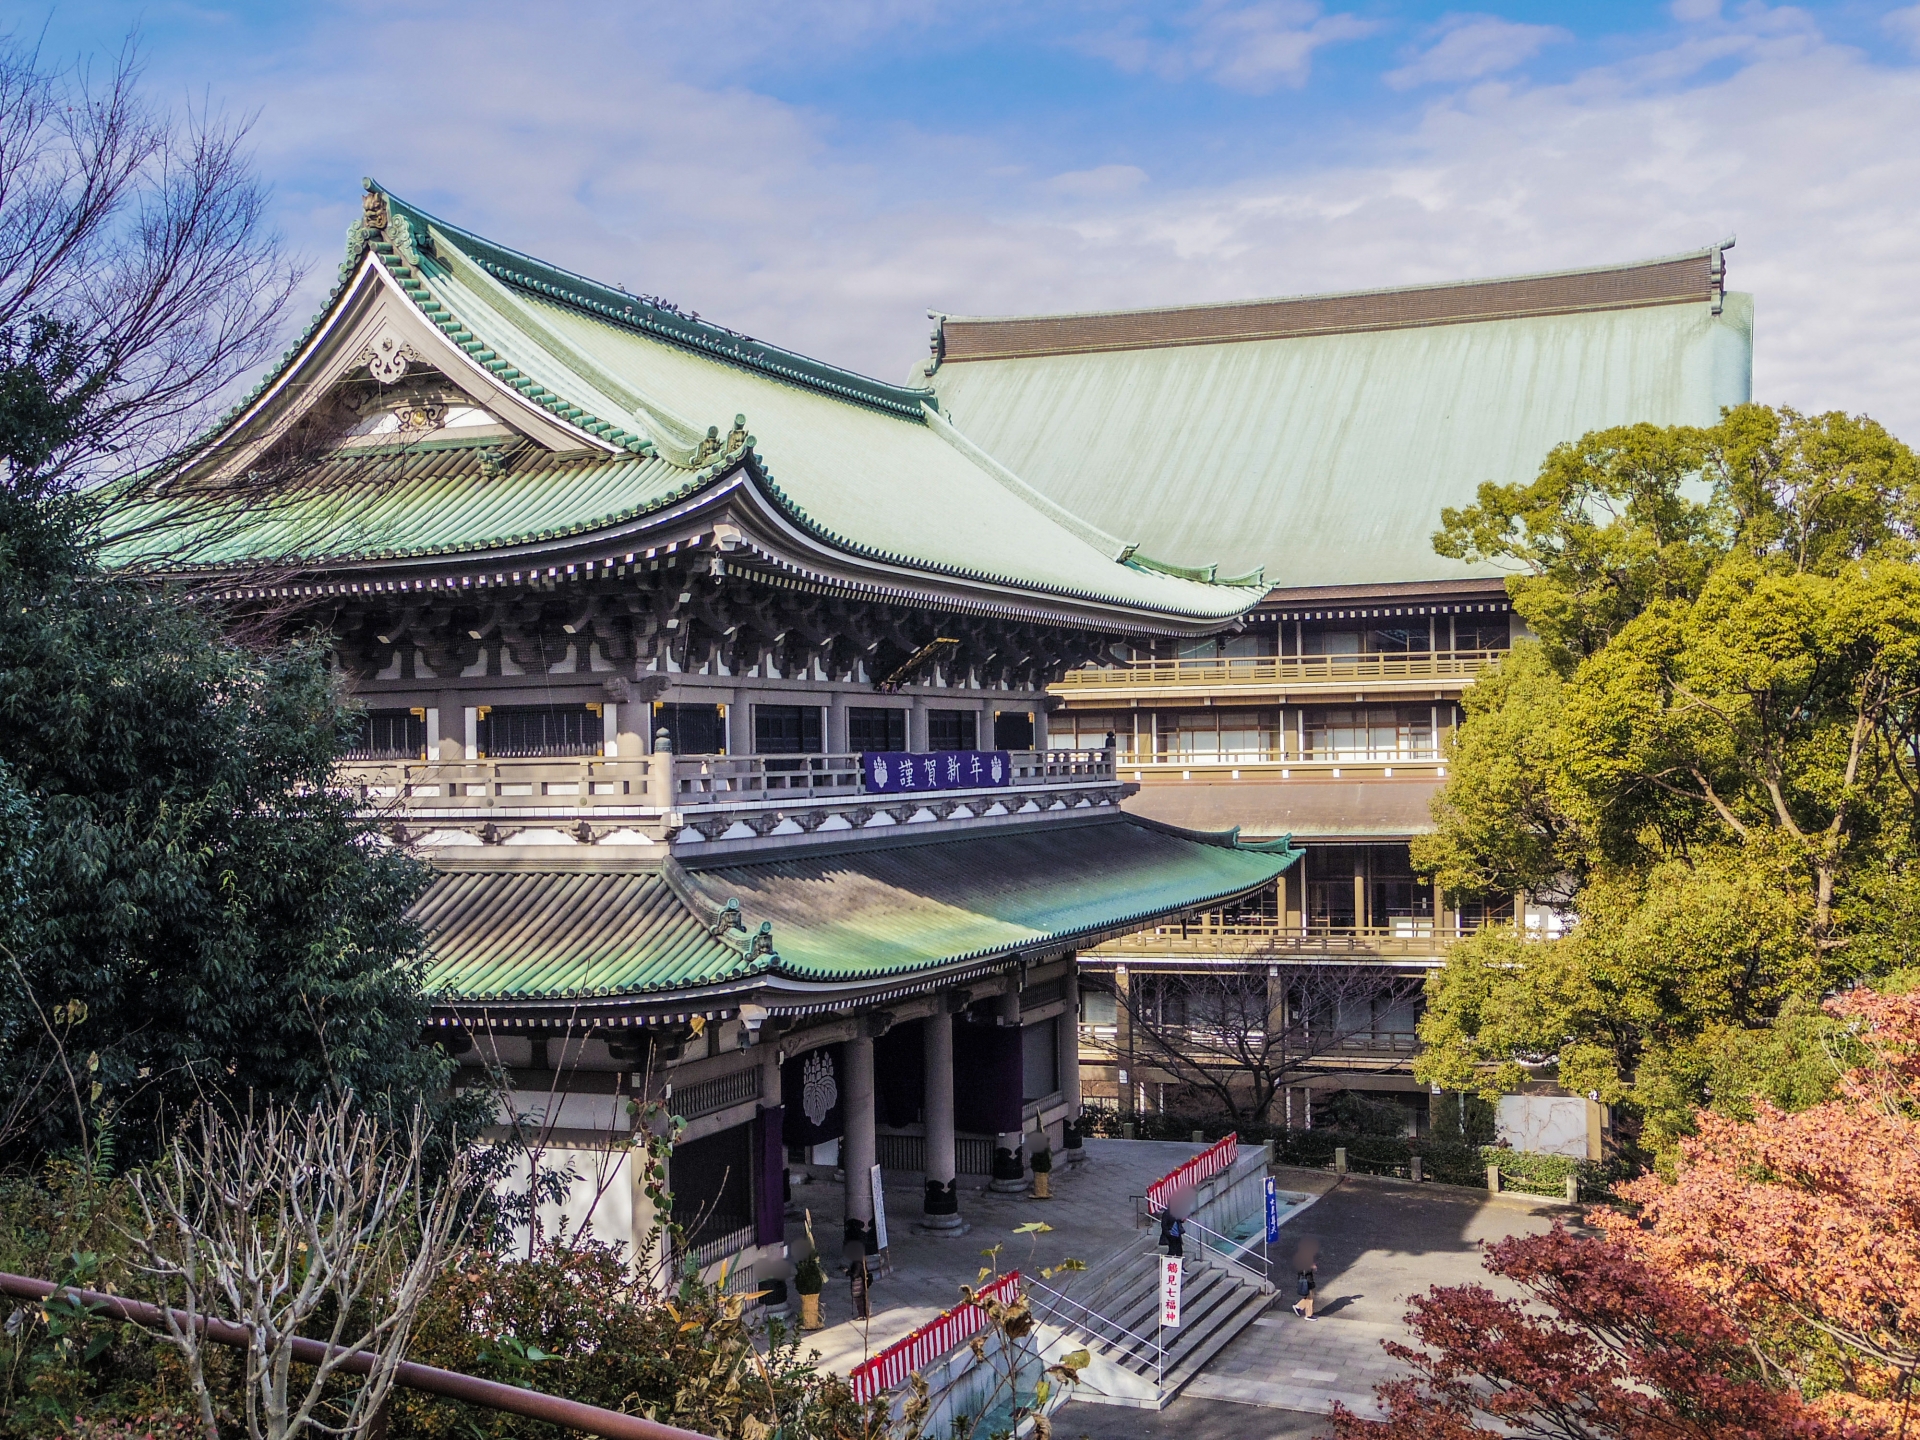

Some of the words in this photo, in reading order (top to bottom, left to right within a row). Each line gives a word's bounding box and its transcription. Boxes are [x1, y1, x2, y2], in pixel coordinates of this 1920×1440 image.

[898, 754, 983, 787] 謹賀新年
[1165, 1262, 1178, 1322] 鶴見七福神
